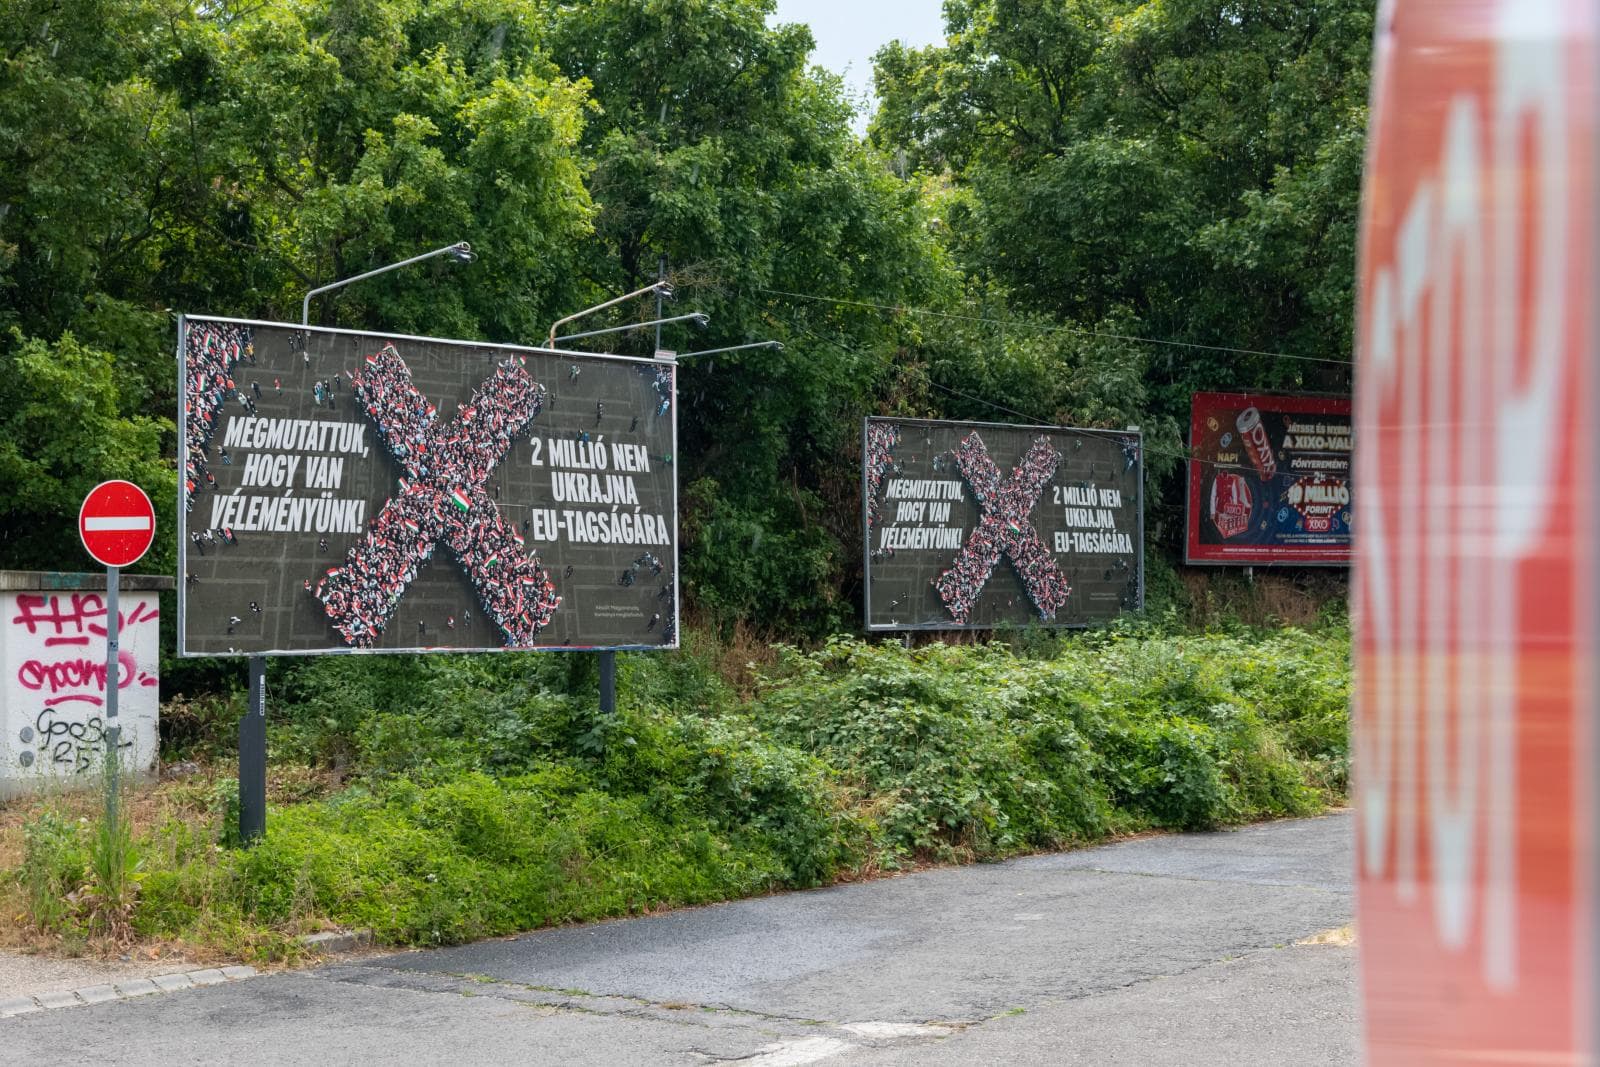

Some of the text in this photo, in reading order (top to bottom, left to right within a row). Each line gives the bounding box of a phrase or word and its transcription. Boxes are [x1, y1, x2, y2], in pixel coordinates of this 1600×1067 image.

[224, 416, 368, 458] MEGMUTATTUK,
[531, 435, 650, 472] 2 MILLIÓ NEM
[242, 454, 343, 489] HOGY VAN
[551, 472, 639, 505] UKRAJNA
[886, 479, 964, 502] MEGMUTATTUK,
[1053, 485, 1121, 507] 2 MILLIÓ NEM
[210, 489, 366, 534] VÉLEMÉNYÜNK!
[896, 501, 950, 522] HOGY VAN
[1065, 508, 1115, 528] UKRAJNA
[533, 506, 670, 545] EU-TAGSÁGÁRA
[1308, 519, 1328, 530] XIXO
[881, 526, 962, 549] VÉLEMÉNYÜNK!
[1055, 530, 1133, 553] EU-TAGSÁGÁRA
